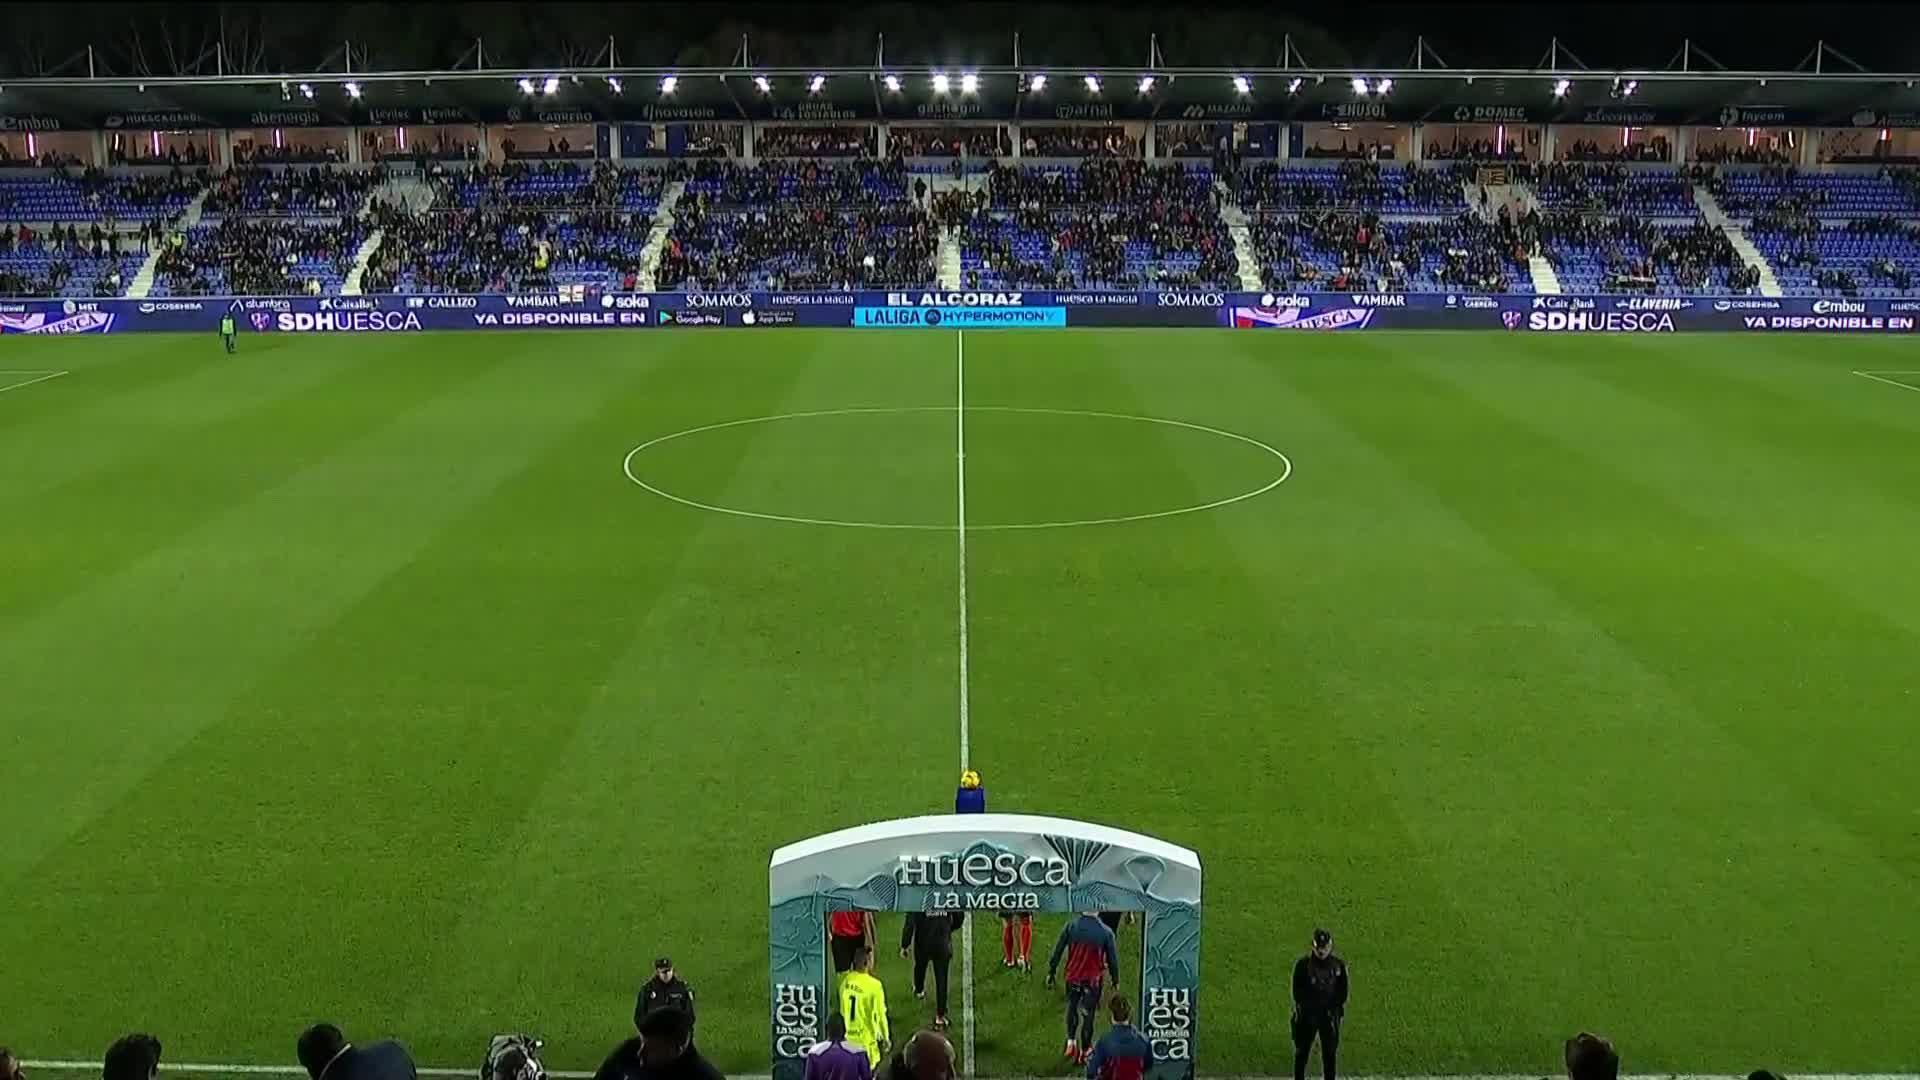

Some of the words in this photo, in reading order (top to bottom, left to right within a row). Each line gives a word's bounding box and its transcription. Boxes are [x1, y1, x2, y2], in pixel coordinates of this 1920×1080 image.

[428, 298, 476, 307] CALLIZO
[515, 297, 558, 307] AMBAR
[617, 295, 648, 308] soka
[686, 295, 752, 307] SOMMOS
[887, 294, 913, 306] EL
[920, 294, 1022, 306] ALCORAZ
[1158, 294, 1224, 306] SOMMOS
[1277, 295, 1309, 306] soka
[1362, 295, 1405, 305] AMBAR
[1812, 300, 1865, 313] embou
[278, 312, 422, 331] SDHUESCA
[475, 314, 498, 324] YA
[503, 313, 615, 324] DISPONIBLE
[620, 313, 645, 324] EN
[865, 309, 920, 324] LALIGA
[943, 311, 1044, 321] HYPERMOTION
[1529, 312, 1675, 331] SDHUESCA
[1745, 317, 1767, 328] YA
[1772, 317, 1883, 329] DISPONIBLE
[1888, 317, 1913, 328] EN
[849, 995, 857, 1021] 1
